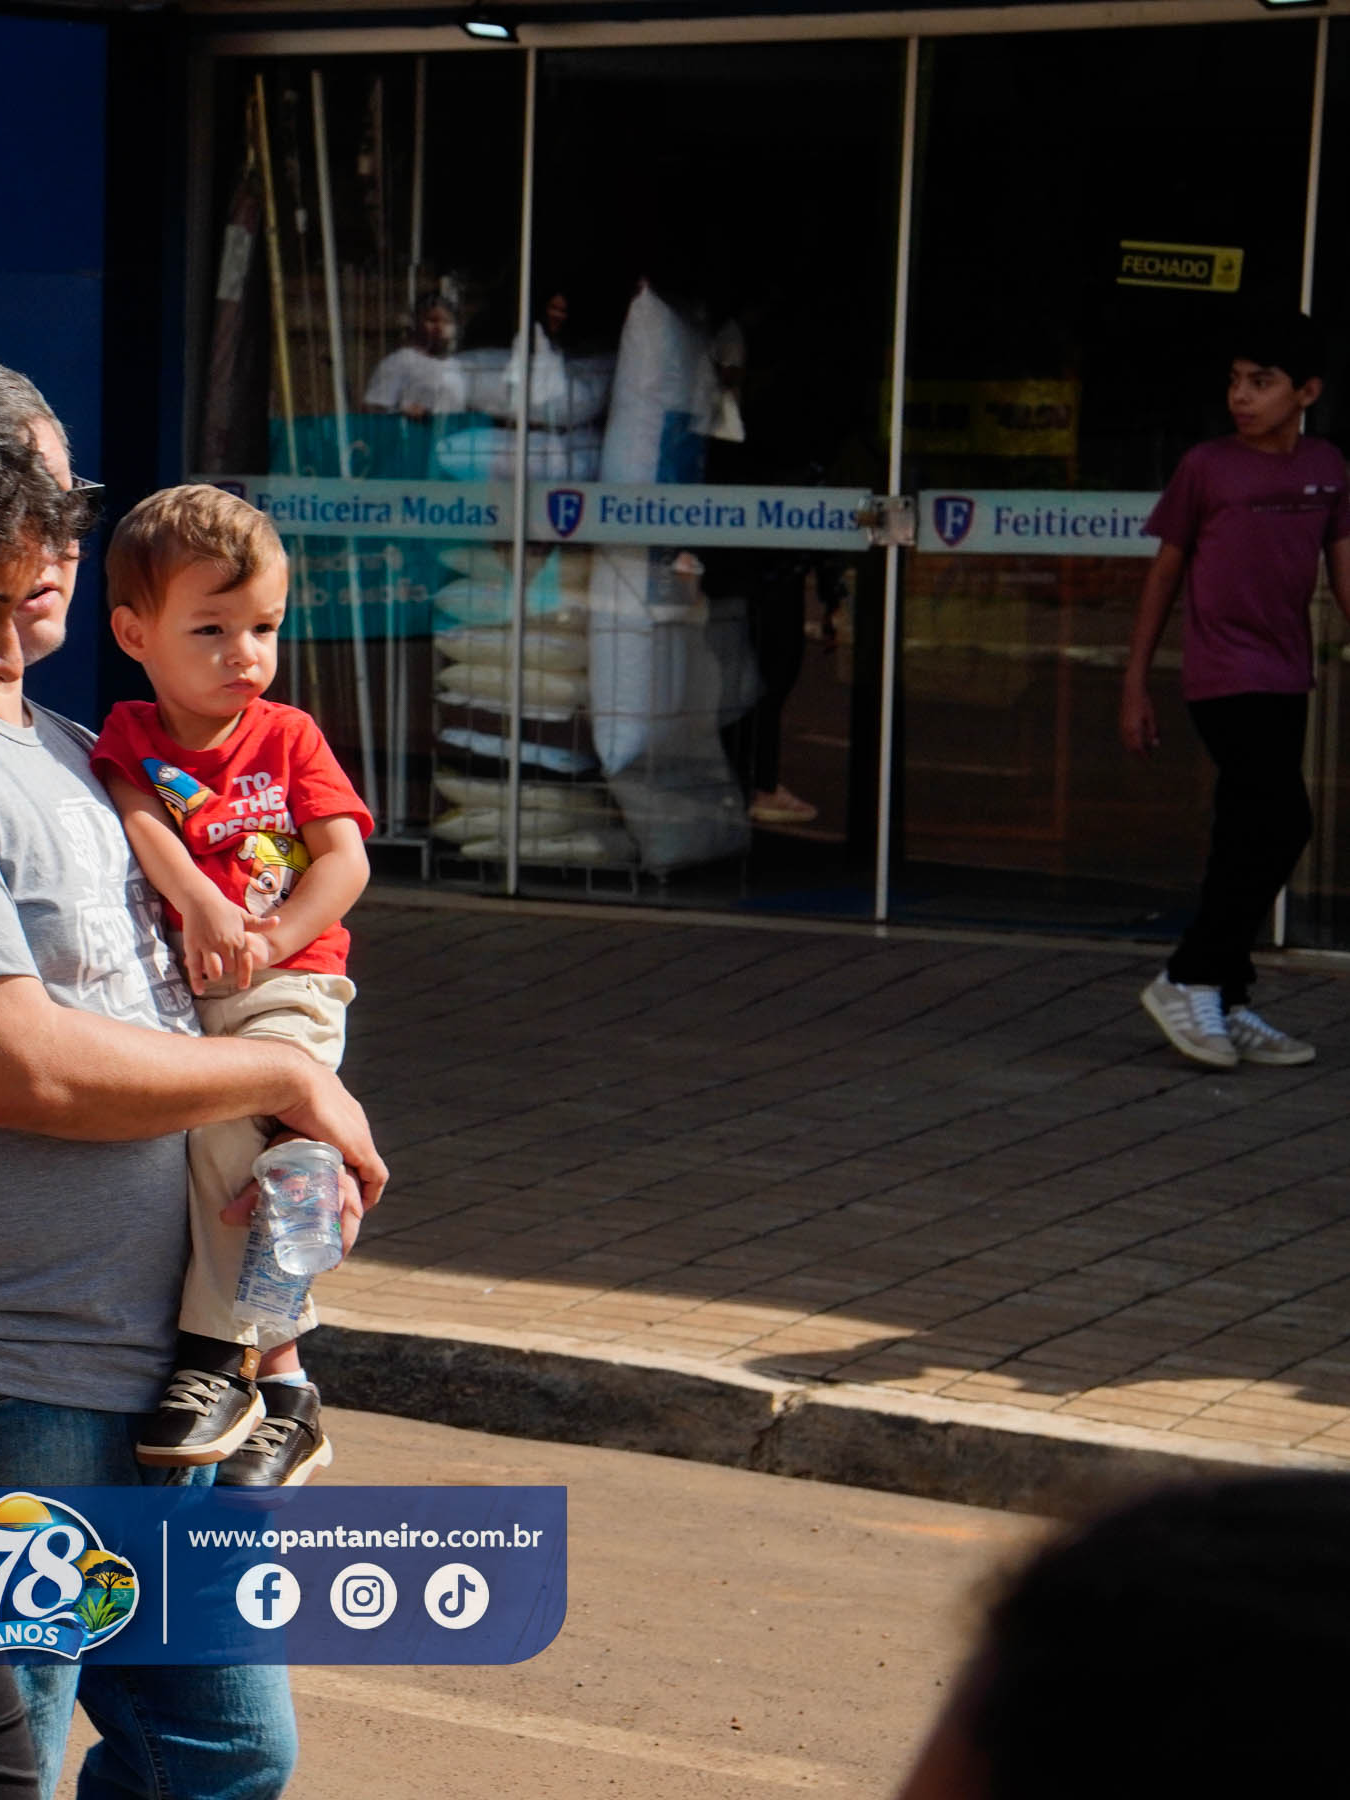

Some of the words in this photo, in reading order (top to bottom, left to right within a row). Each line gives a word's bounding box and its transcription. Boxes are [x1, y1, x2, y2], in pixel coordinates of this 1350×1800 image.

[1121, 253, 1210, 280] FECHADO
[256, 494, 391, 523] Feiticeira
[402, 496, 498, 526] Modas
[600, 496, 745, 528] Feiticeira
[757, 500, 861, 532] Modas
[232, 771, 271, 797] TO
[228, 786, 284, 815] THE
[207, 811, 298, 845] RESCU
